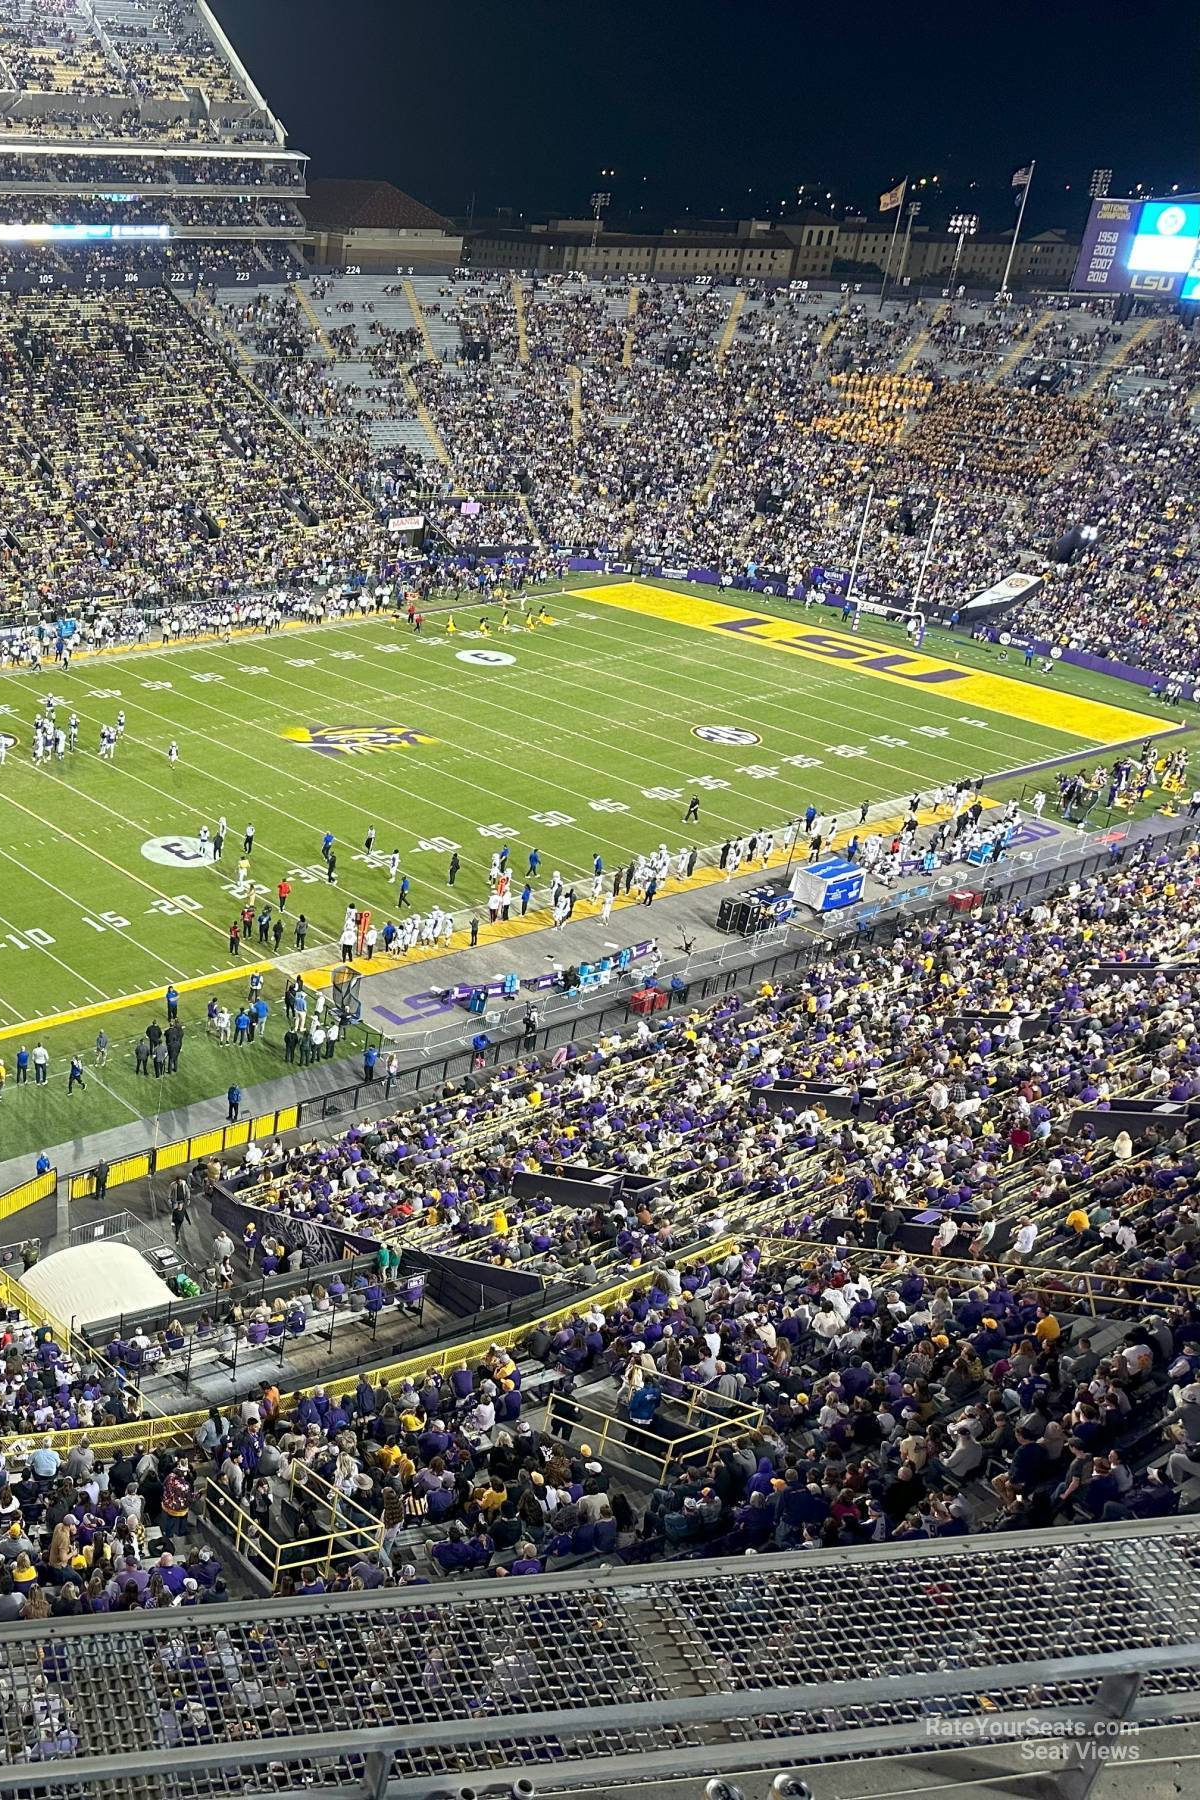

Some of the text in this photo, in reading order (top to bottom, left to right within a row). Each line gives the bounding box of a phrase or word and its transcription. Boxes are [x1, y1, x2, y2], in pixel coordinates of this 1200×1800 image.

[1097, 232, 1119, 243] 1958
[1093, 245, 1116, 256] 2003
[345, 266, 361, 275] 224
[1090, 258, 1113, 270] 2007
[39, 274, 54, 284] 105
[124, 273, 139, 282] 106
[171, 273, 185, 282] 222
[236, 272, 250, 281] 223
[695, 275, 712, 285] 227
[1087, 271, 1108, 283] 2019
[1130, 274, 1175, 291] LSU
[789, 280, 808, 290] 228
[711, 617, 975, 684] LSU
[958, 716, 990, 728] 5
[910, 725, 950, 739] 10
[869, 734, 909, 748] 15
[824, 743, 868, 758] 20
[781, 754, 825, 769] 25
[734, 764, 780, 779] 30
[686, 775, 732, 790] 35
[640, 786, 684, 801] 40
[587, 798, 632, 813] 45
[527, 810, 577, 827] 50
[476, 822, 520, 839] 45
[417, 836, 462, 853] 40
[287, 864, 338, 885] 30
[151, 894, 205, 916] 20
[81, 910, 132, 932] 15
[5, 927, 56, 950] 10
